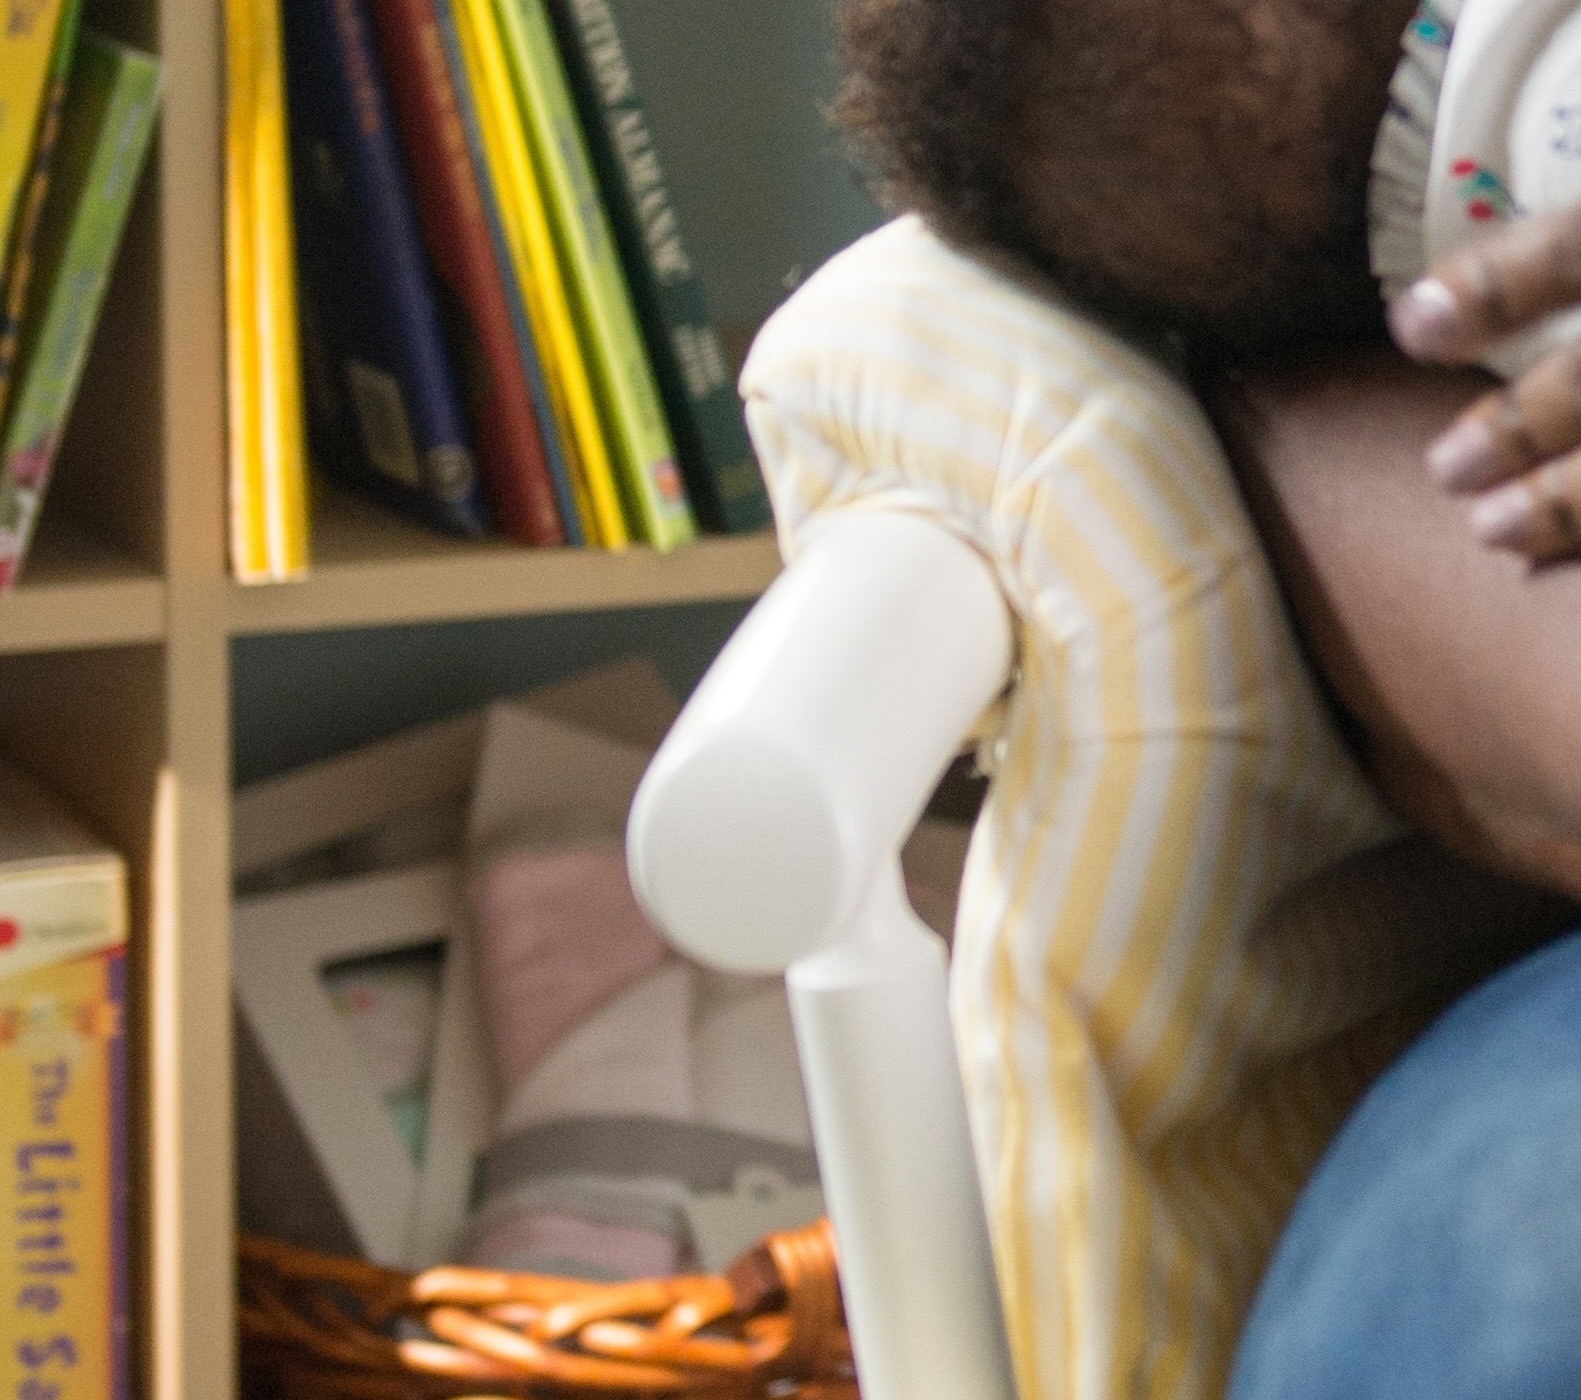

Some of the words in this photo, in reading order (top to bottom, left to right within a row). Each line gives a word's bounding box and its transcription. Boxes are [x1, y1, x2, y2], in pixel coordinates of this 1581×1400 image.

[608, 110, 690, 287] ALMANAC
[31, 1057, 70, 1126] The
[15, 1140, 81, 1314] Little
